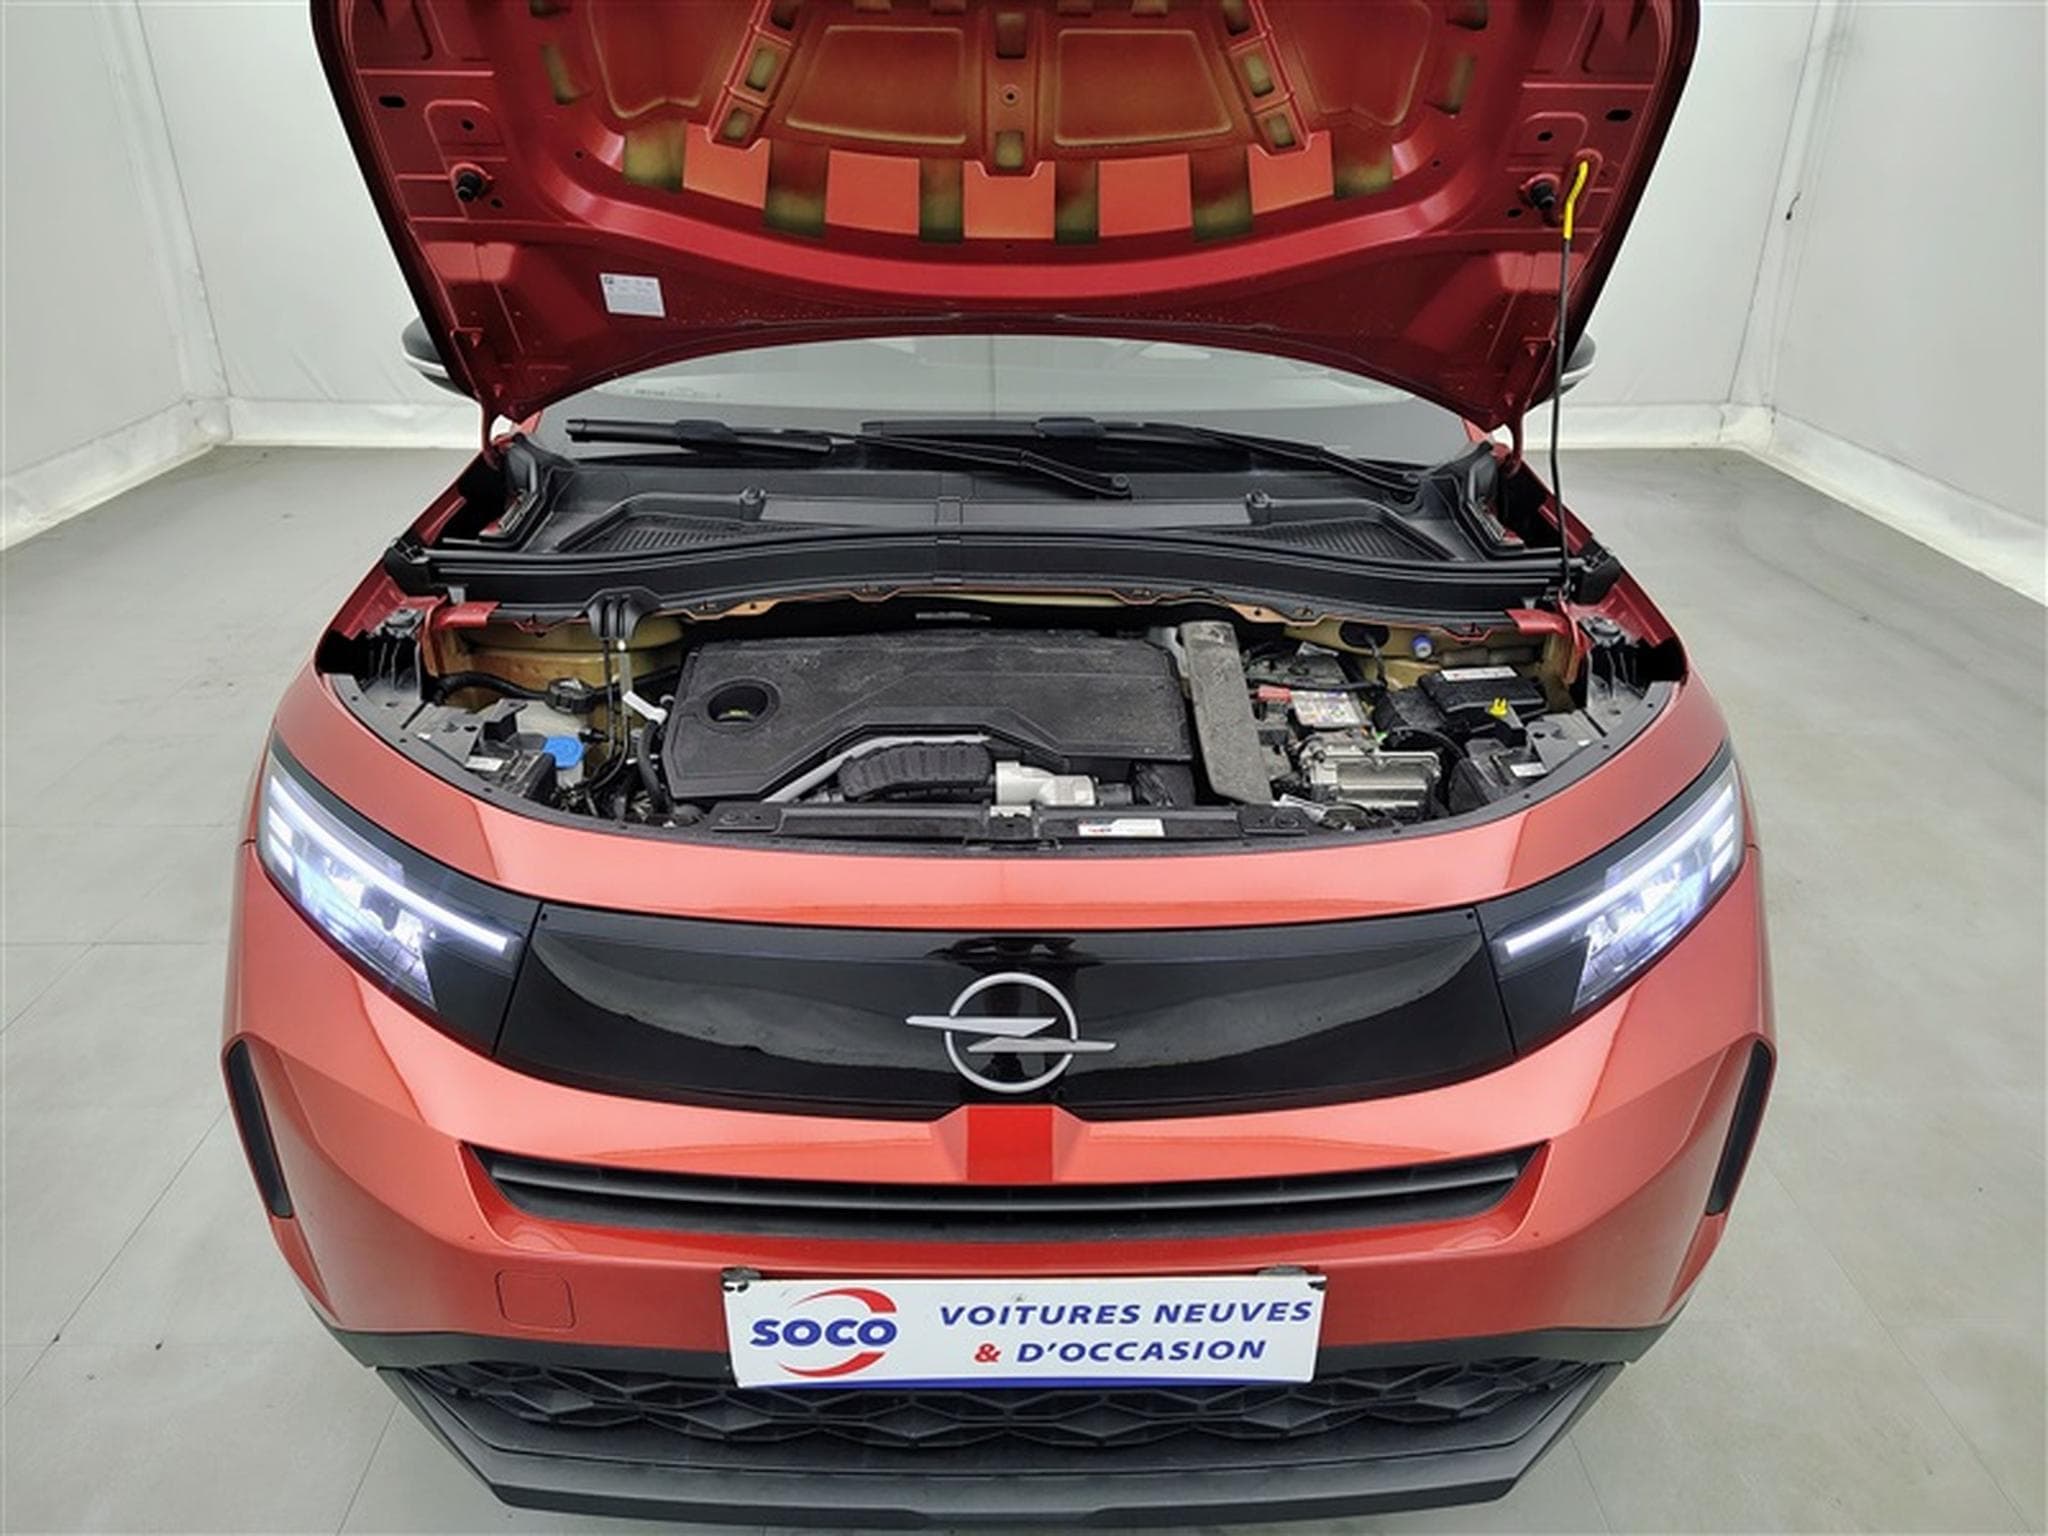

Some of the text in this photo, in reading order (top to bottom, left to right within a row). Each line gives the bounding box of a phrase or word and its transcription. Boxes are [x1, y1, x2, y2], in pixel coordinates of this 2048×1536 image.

[941, 1301, 1312, 1326] VOITURES NEUVES
[749, 1319, 898, 1347] SOCO
[975, 1340, 1266, 1363] & D'OCCASION
